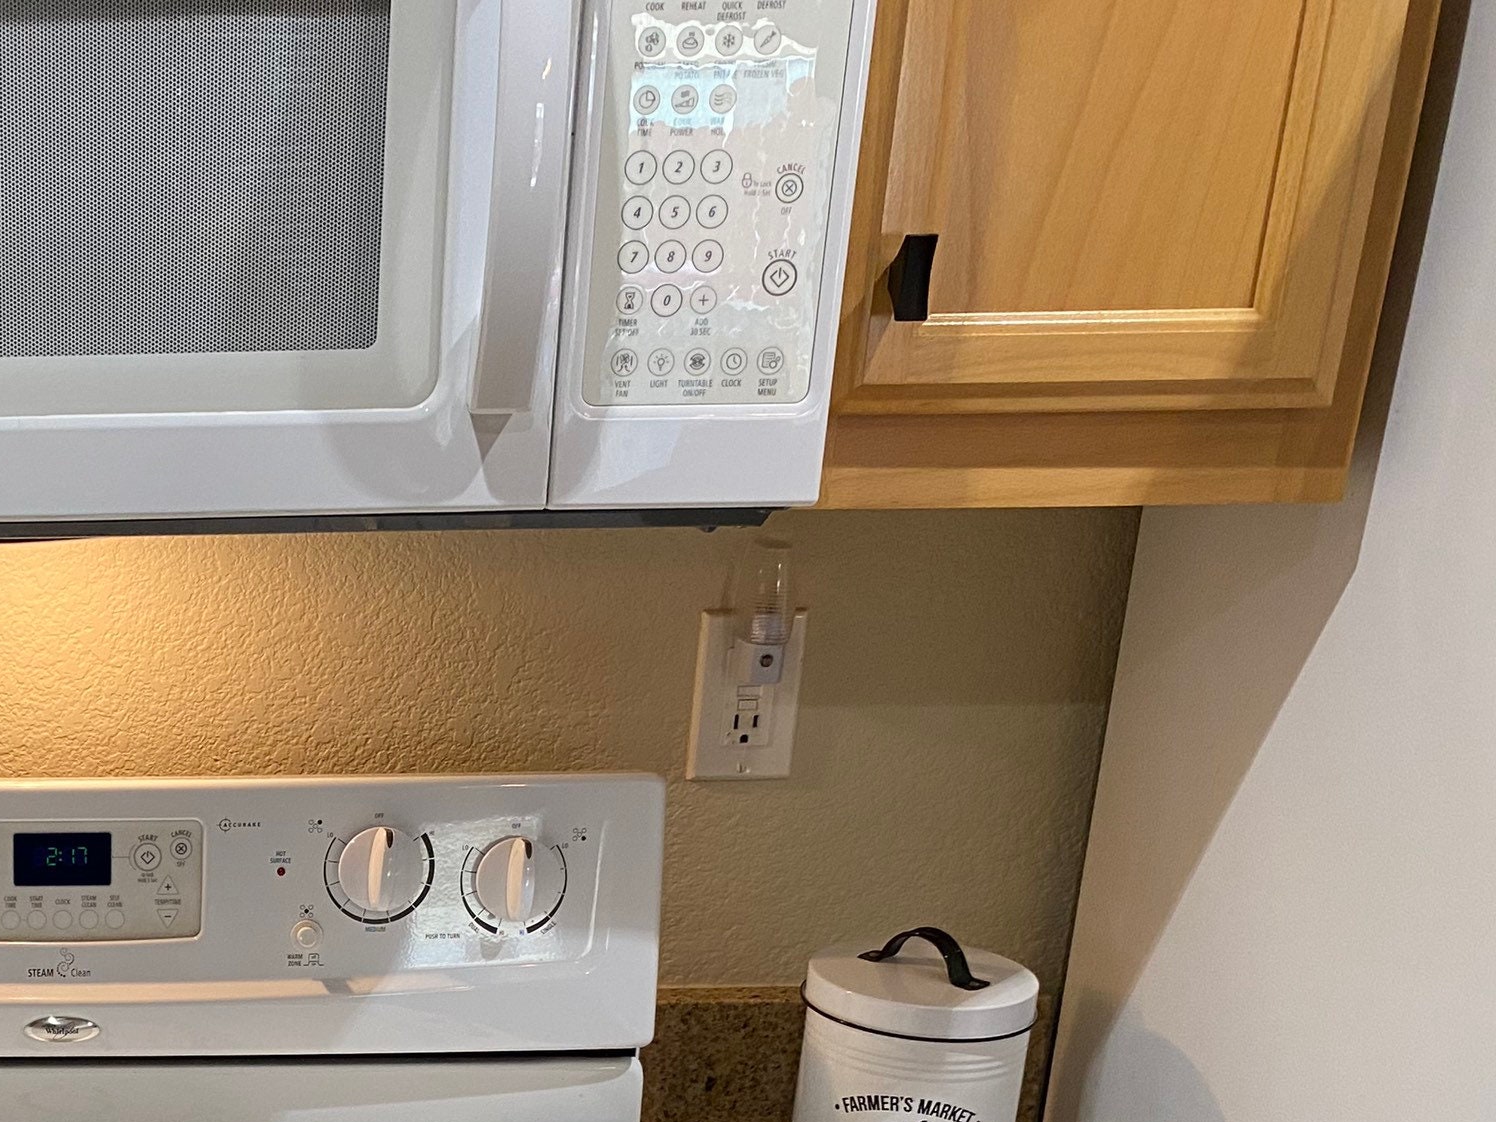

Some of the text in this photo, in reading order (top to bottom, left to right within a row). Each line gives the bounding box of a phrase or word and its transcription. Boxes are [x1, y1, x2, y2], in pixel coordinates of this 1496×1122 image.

[646, 2, 664, 11] COOK
[681, 1, 706, 10] REHEAT
[722, 1, 742, 10] QUICK
[757, 0, 786, 10] DEFROST
[717, 12, 746, 21] DEFROST
[669, 128, 694, 137] POWER
[674, 162, 684, 173] 2
[712, 161, 721, 173] 3
[776, 163, 806, 175] CANCEL
[633, 206, 717, 218] 4 5 6
[780, 206, 793, 216] OFF
[630, 250, 713, 263] 7 8 9
[768, 250, 797, 260] START
[618, 318, 638, 327] TIMER
[614, 380, 631, 388] VENT
[650, 379, 668, 388] LIGHT
[677, 379, 713, 388] TURNTABLE
[721, 378, 742, 388] CLOCK
[758, 378, 777, 387] SETUP
[615, 389, 629, 398] FAN
[757, 387, 777, 396] MENU
[45, 846, 89, 867] 2:17
[27, 968, 92, 978] STEAM Clean
[842, 1094, 914, 1113] FARMER'S
